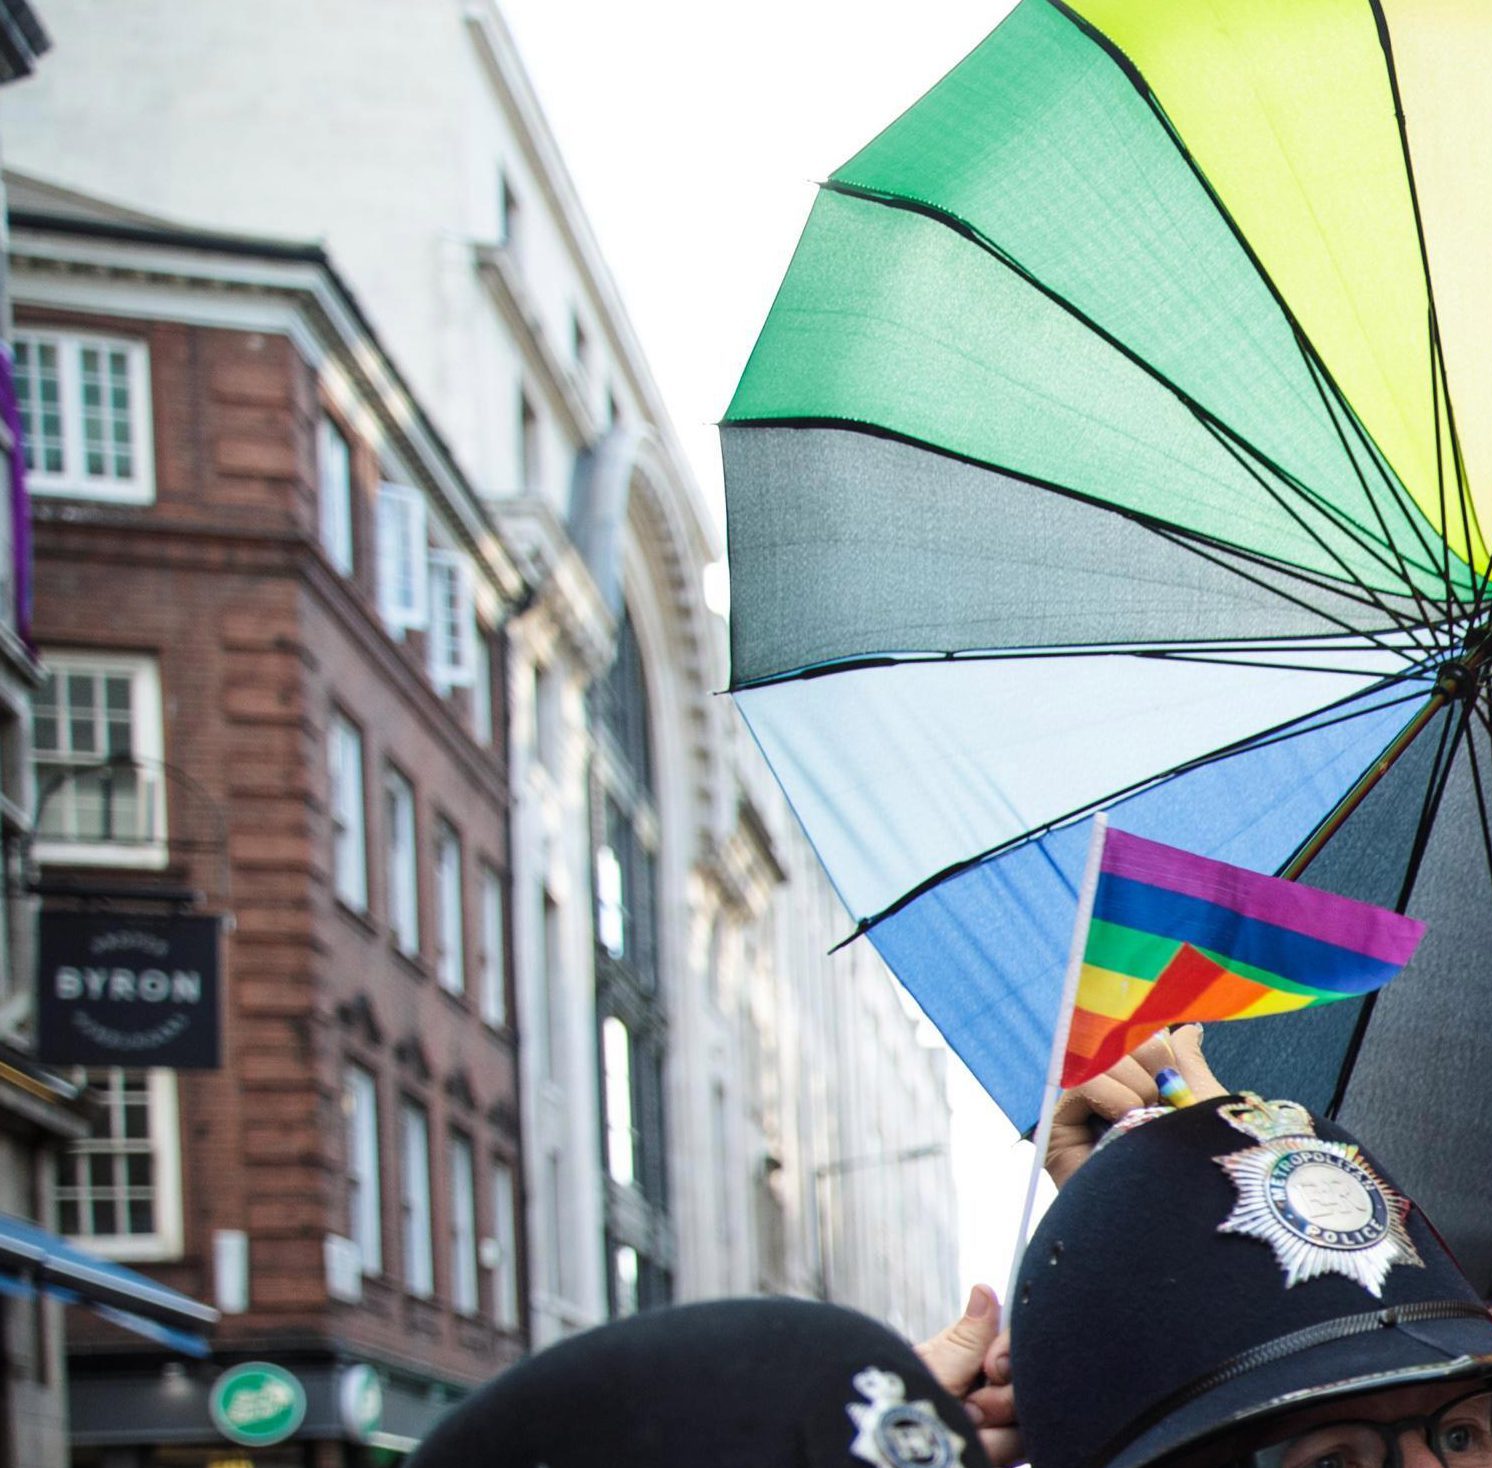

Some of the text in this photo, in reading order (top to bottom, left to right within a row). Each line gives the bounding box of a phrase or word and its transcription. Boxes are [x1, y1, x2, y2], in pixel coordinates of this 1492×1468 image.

[55, 965, 201, 1004] BYRON
[1270, 1151, 1376, 1202] METROPOLITAN
[1305, 1218, 1384, 1245] POLICE
